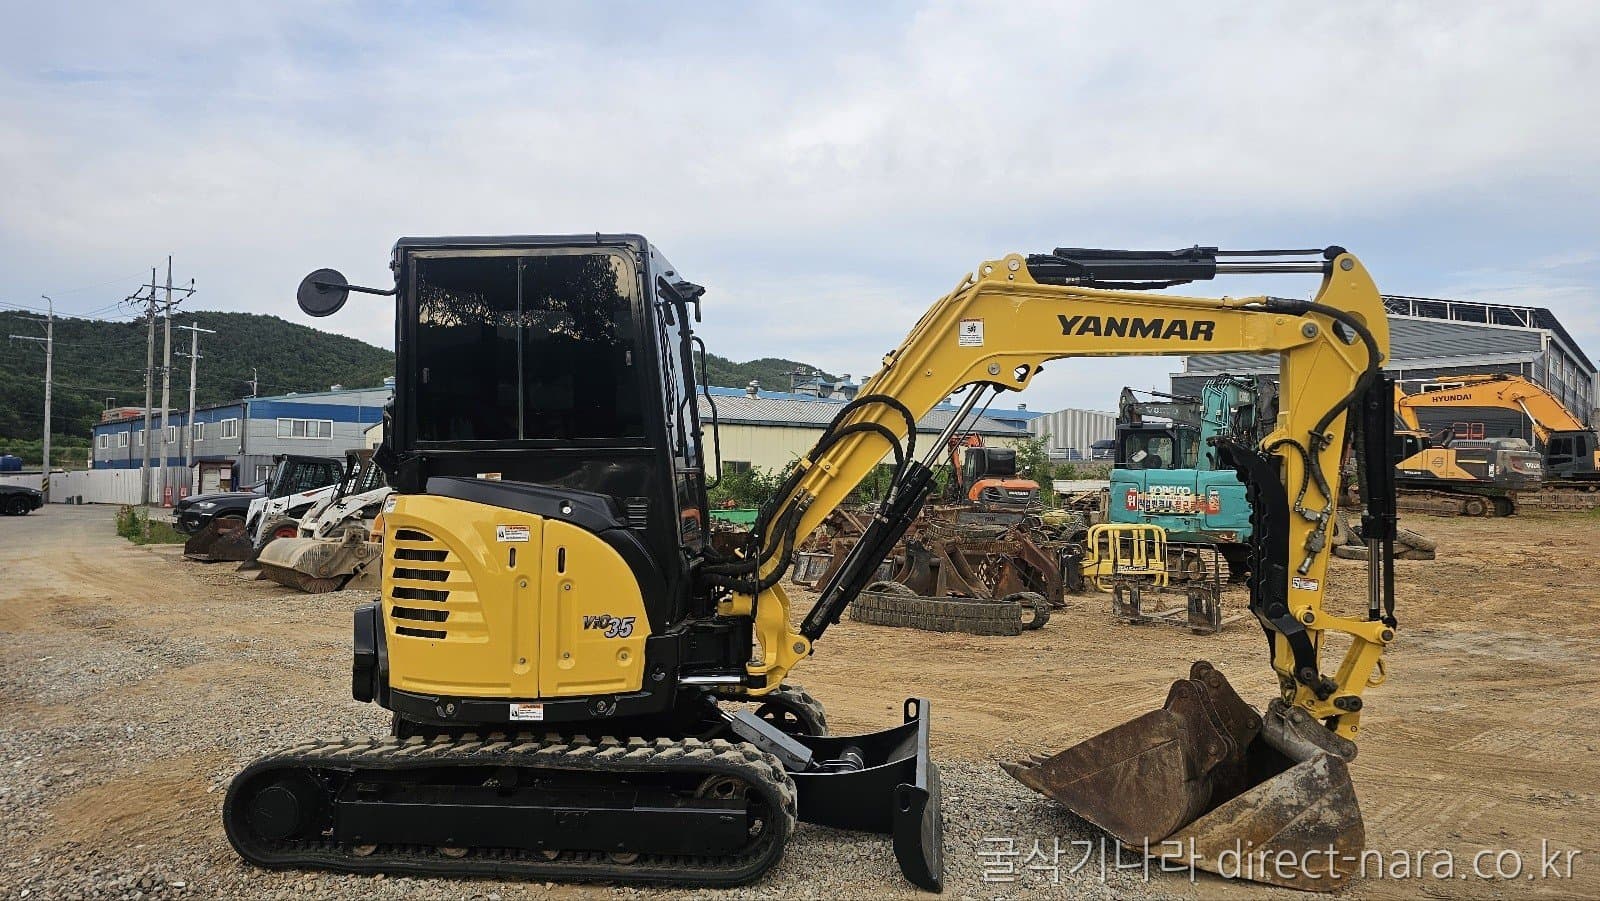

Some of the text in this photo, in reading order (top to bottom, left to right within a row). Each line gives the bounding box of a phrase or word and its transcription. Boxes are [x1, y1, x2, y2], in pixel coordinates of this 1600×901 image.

[1057, 314, 1216, 342] YANMAR
[1432, 394, 1472, 403] HYUNDAI
[1148, 485, 1191, 495] KOBELCO
